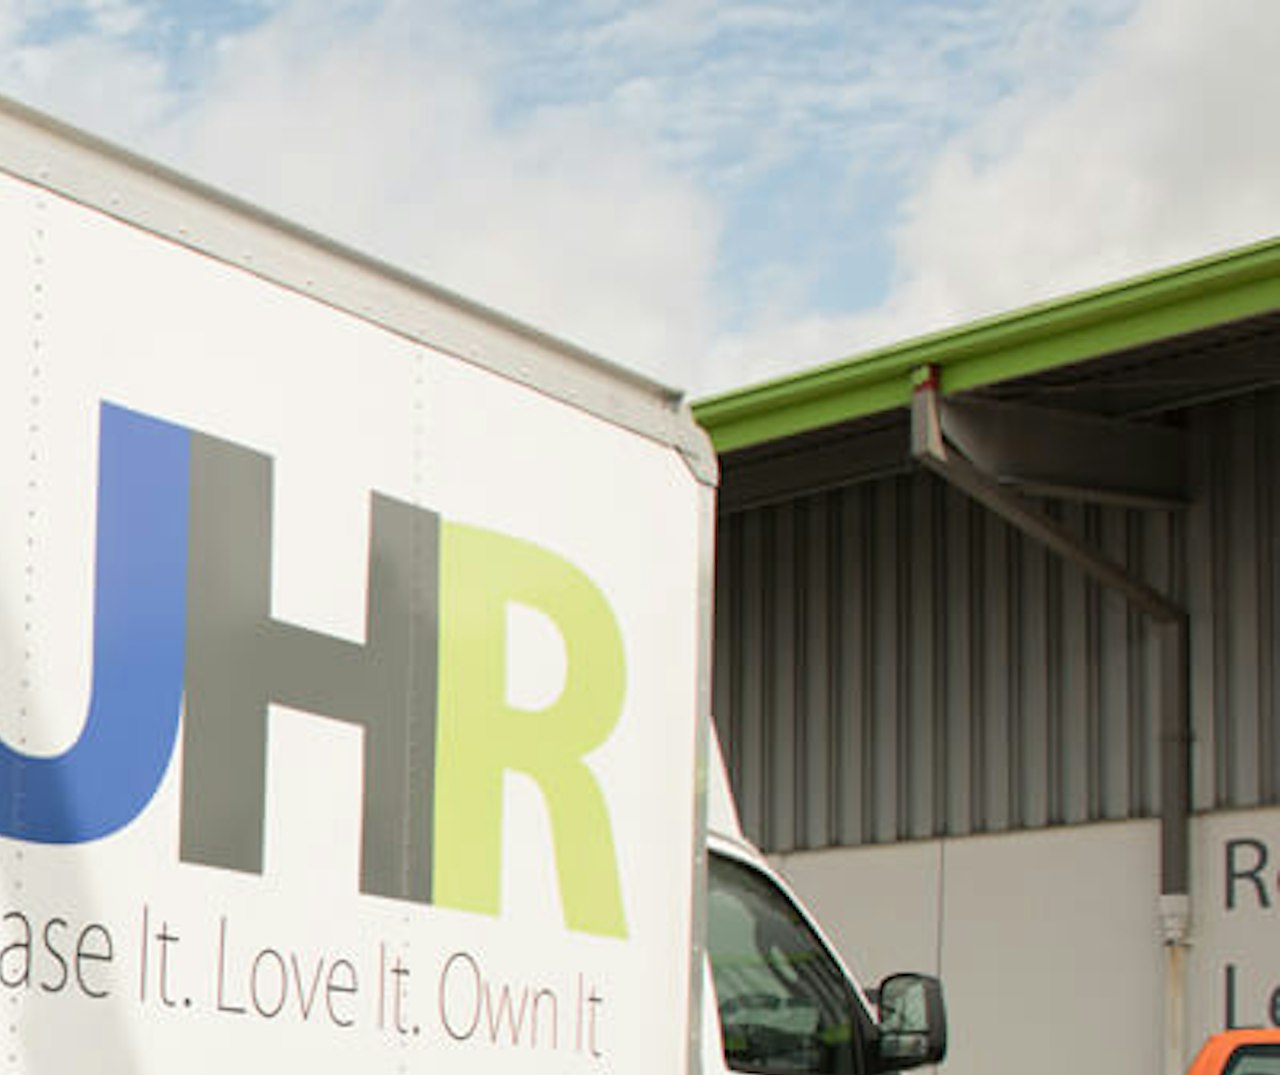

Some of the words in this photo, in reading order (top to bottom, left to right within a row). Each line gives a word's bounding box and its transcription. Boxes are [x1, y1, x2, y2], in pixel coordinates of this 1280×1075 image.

[1226, 838, 1280, 909] R
[139, 904, 192, 1008] It.
[217, 916, 359, 1028] Love
[378, 942, 421, 1036] It.
[439, 952, 559, 1051] Own
[576, 972, 604, 1057] It
